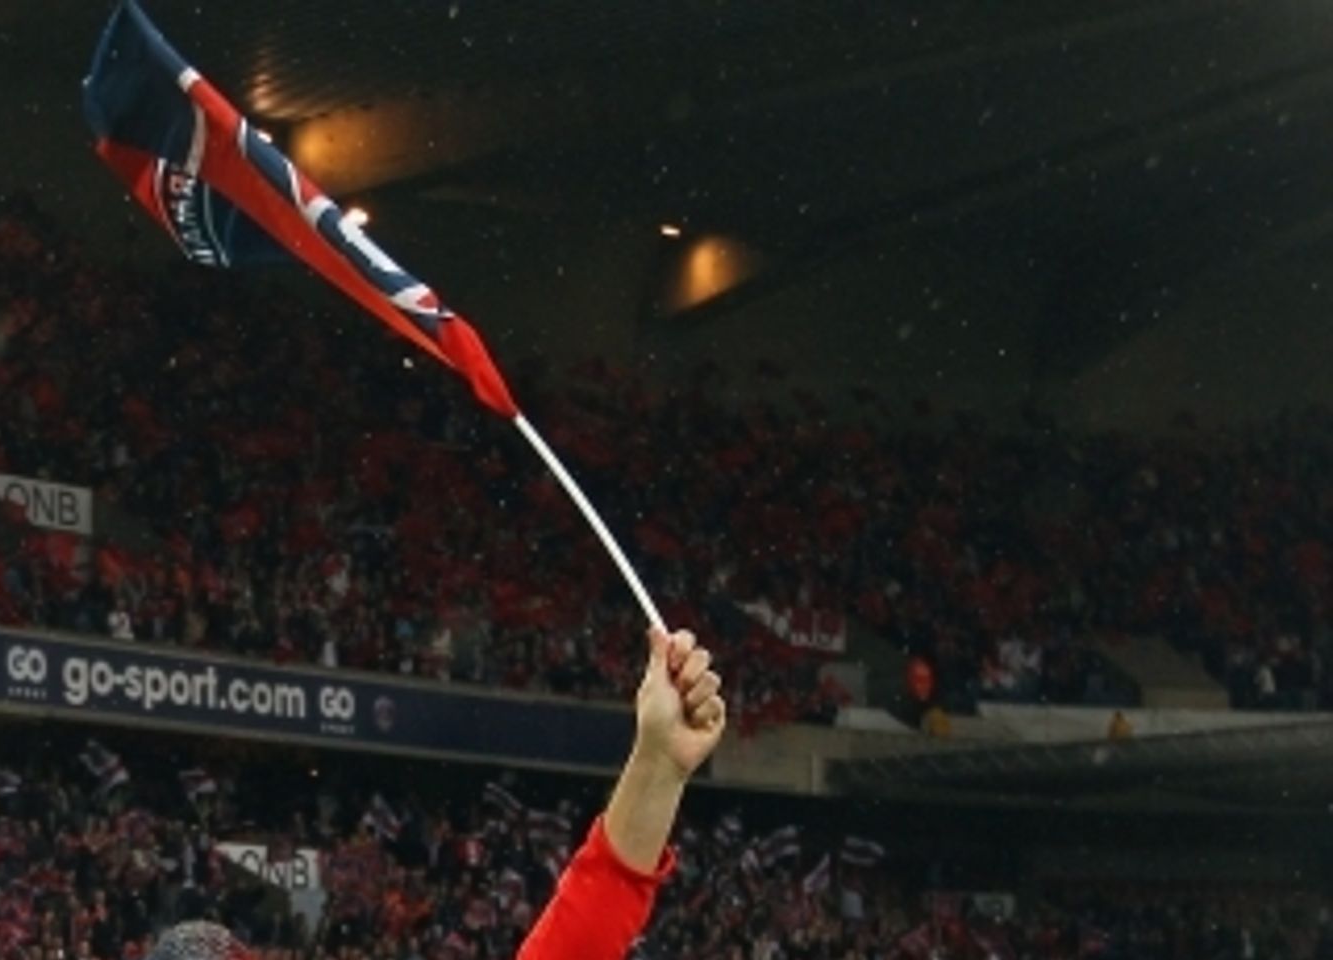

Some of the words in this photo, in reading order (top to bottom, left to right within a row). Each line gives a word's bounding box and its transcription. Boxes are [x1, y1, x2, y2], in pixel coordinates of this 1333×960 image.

[7, 645, 47, 684] GO
[62, 657, 306, 719] go-sport.com
[320, 686, 355, 721] GO
